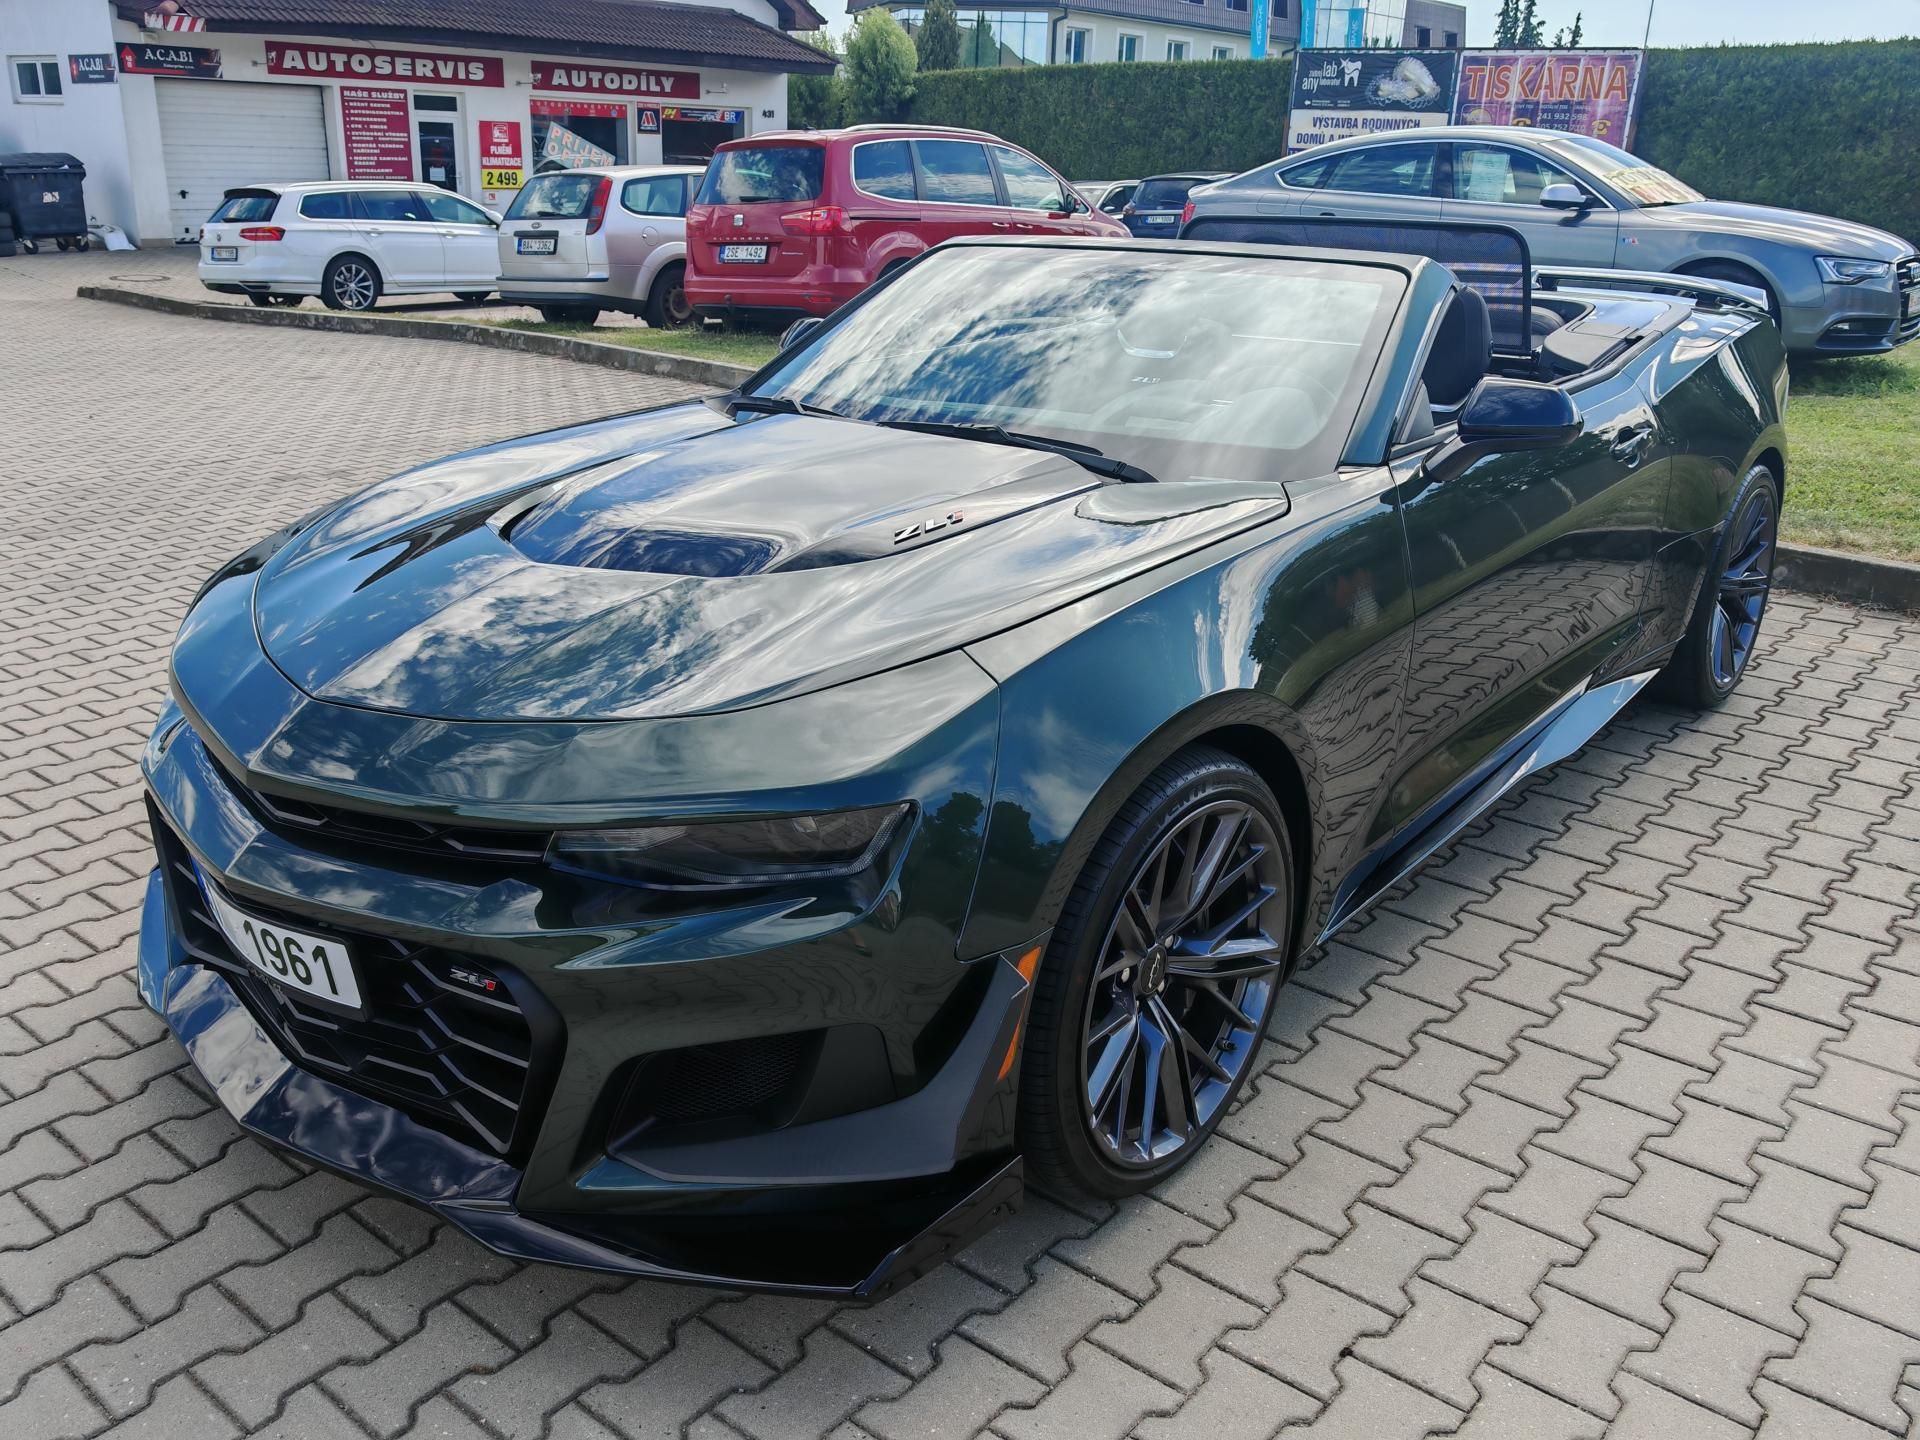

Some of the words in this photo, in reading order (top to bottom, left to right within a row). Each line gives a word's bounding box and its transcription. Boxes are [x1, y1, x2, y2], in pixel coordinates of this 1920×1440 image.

[282, 49, 485, 81] AUTOSERVIS
[1322, 60, 1338, 78] lab
[551, 68, 675, 93] AUTODÍLY
[1302, 77, 1319, 94] any
[1465, 58, 1628, 102] TISKÁRNA
[343, 89, 369, 98] NAŠE
[370, 90, 405, 99] SLUŽBY
[762, 109, 775, 119] 431
[1553, 112, 1570, 121] 932
[1312, 114, 1358, 130] VÝSTAVBA
[1361, 117, 1421, 130] RODINNÝCH
[1296, 130, 1325, 145] DOMŮ
[490, 143, 513, 155] PLNĚNÍ
[482, 156, 522, 167] KLIMATIZACE
[486, 171, 494, 186] 2
[726, 247, 739, 258] 2SE
[745, 247, 763, 259] 1492
[893, 509, 964, 546] ZL1
[243, 919, 339, 996] 1961
